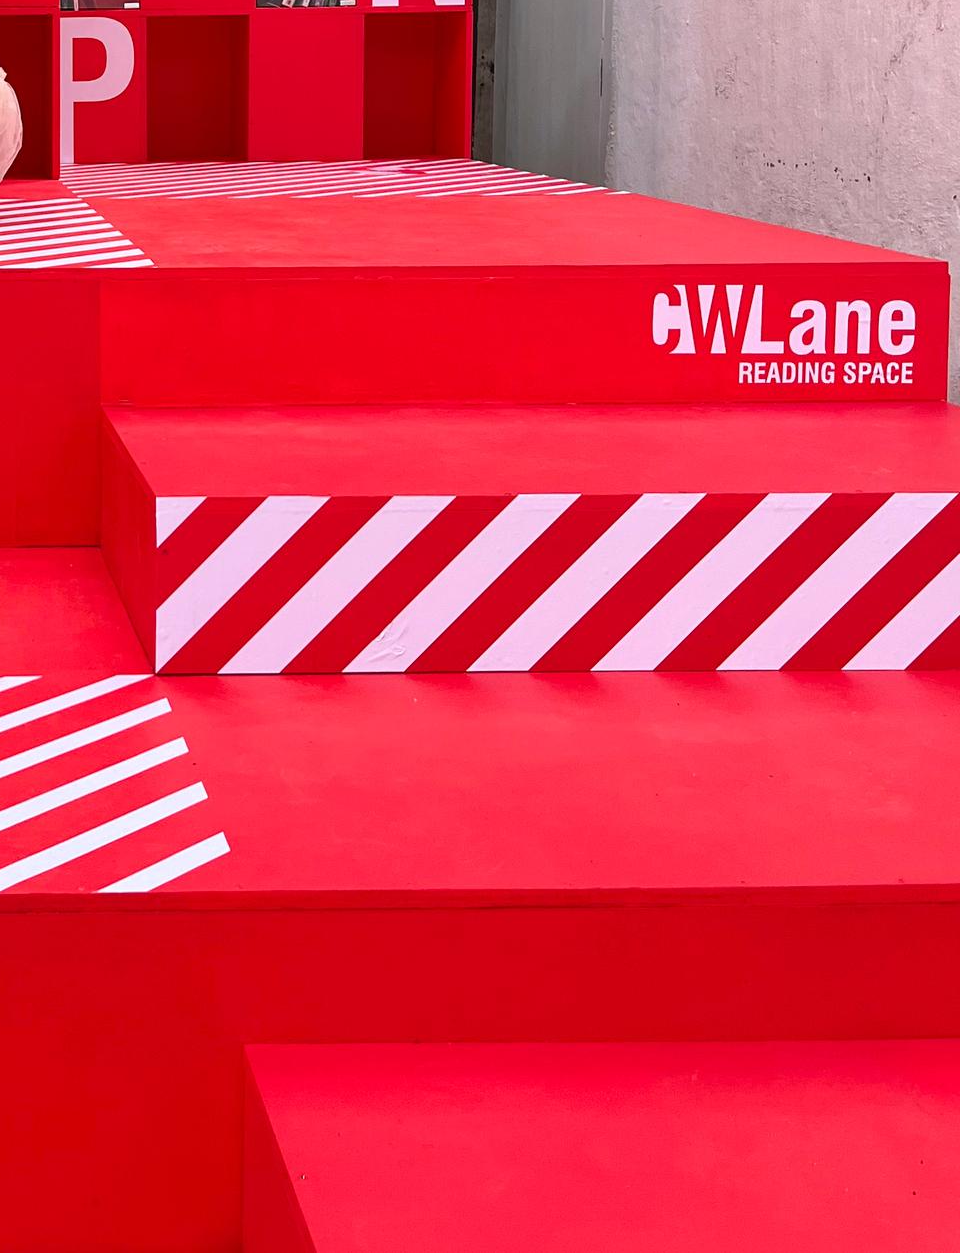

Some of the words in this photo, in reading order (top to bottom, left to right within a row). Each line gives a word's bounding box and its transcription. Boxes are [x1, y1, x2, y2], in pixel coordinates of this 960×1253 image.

[60, 17, 134, 165] P
[652, 284, 916, 356] CWLane
[738, 362, 835, 384] READING
[842, 362, 914, 384] SPACE
